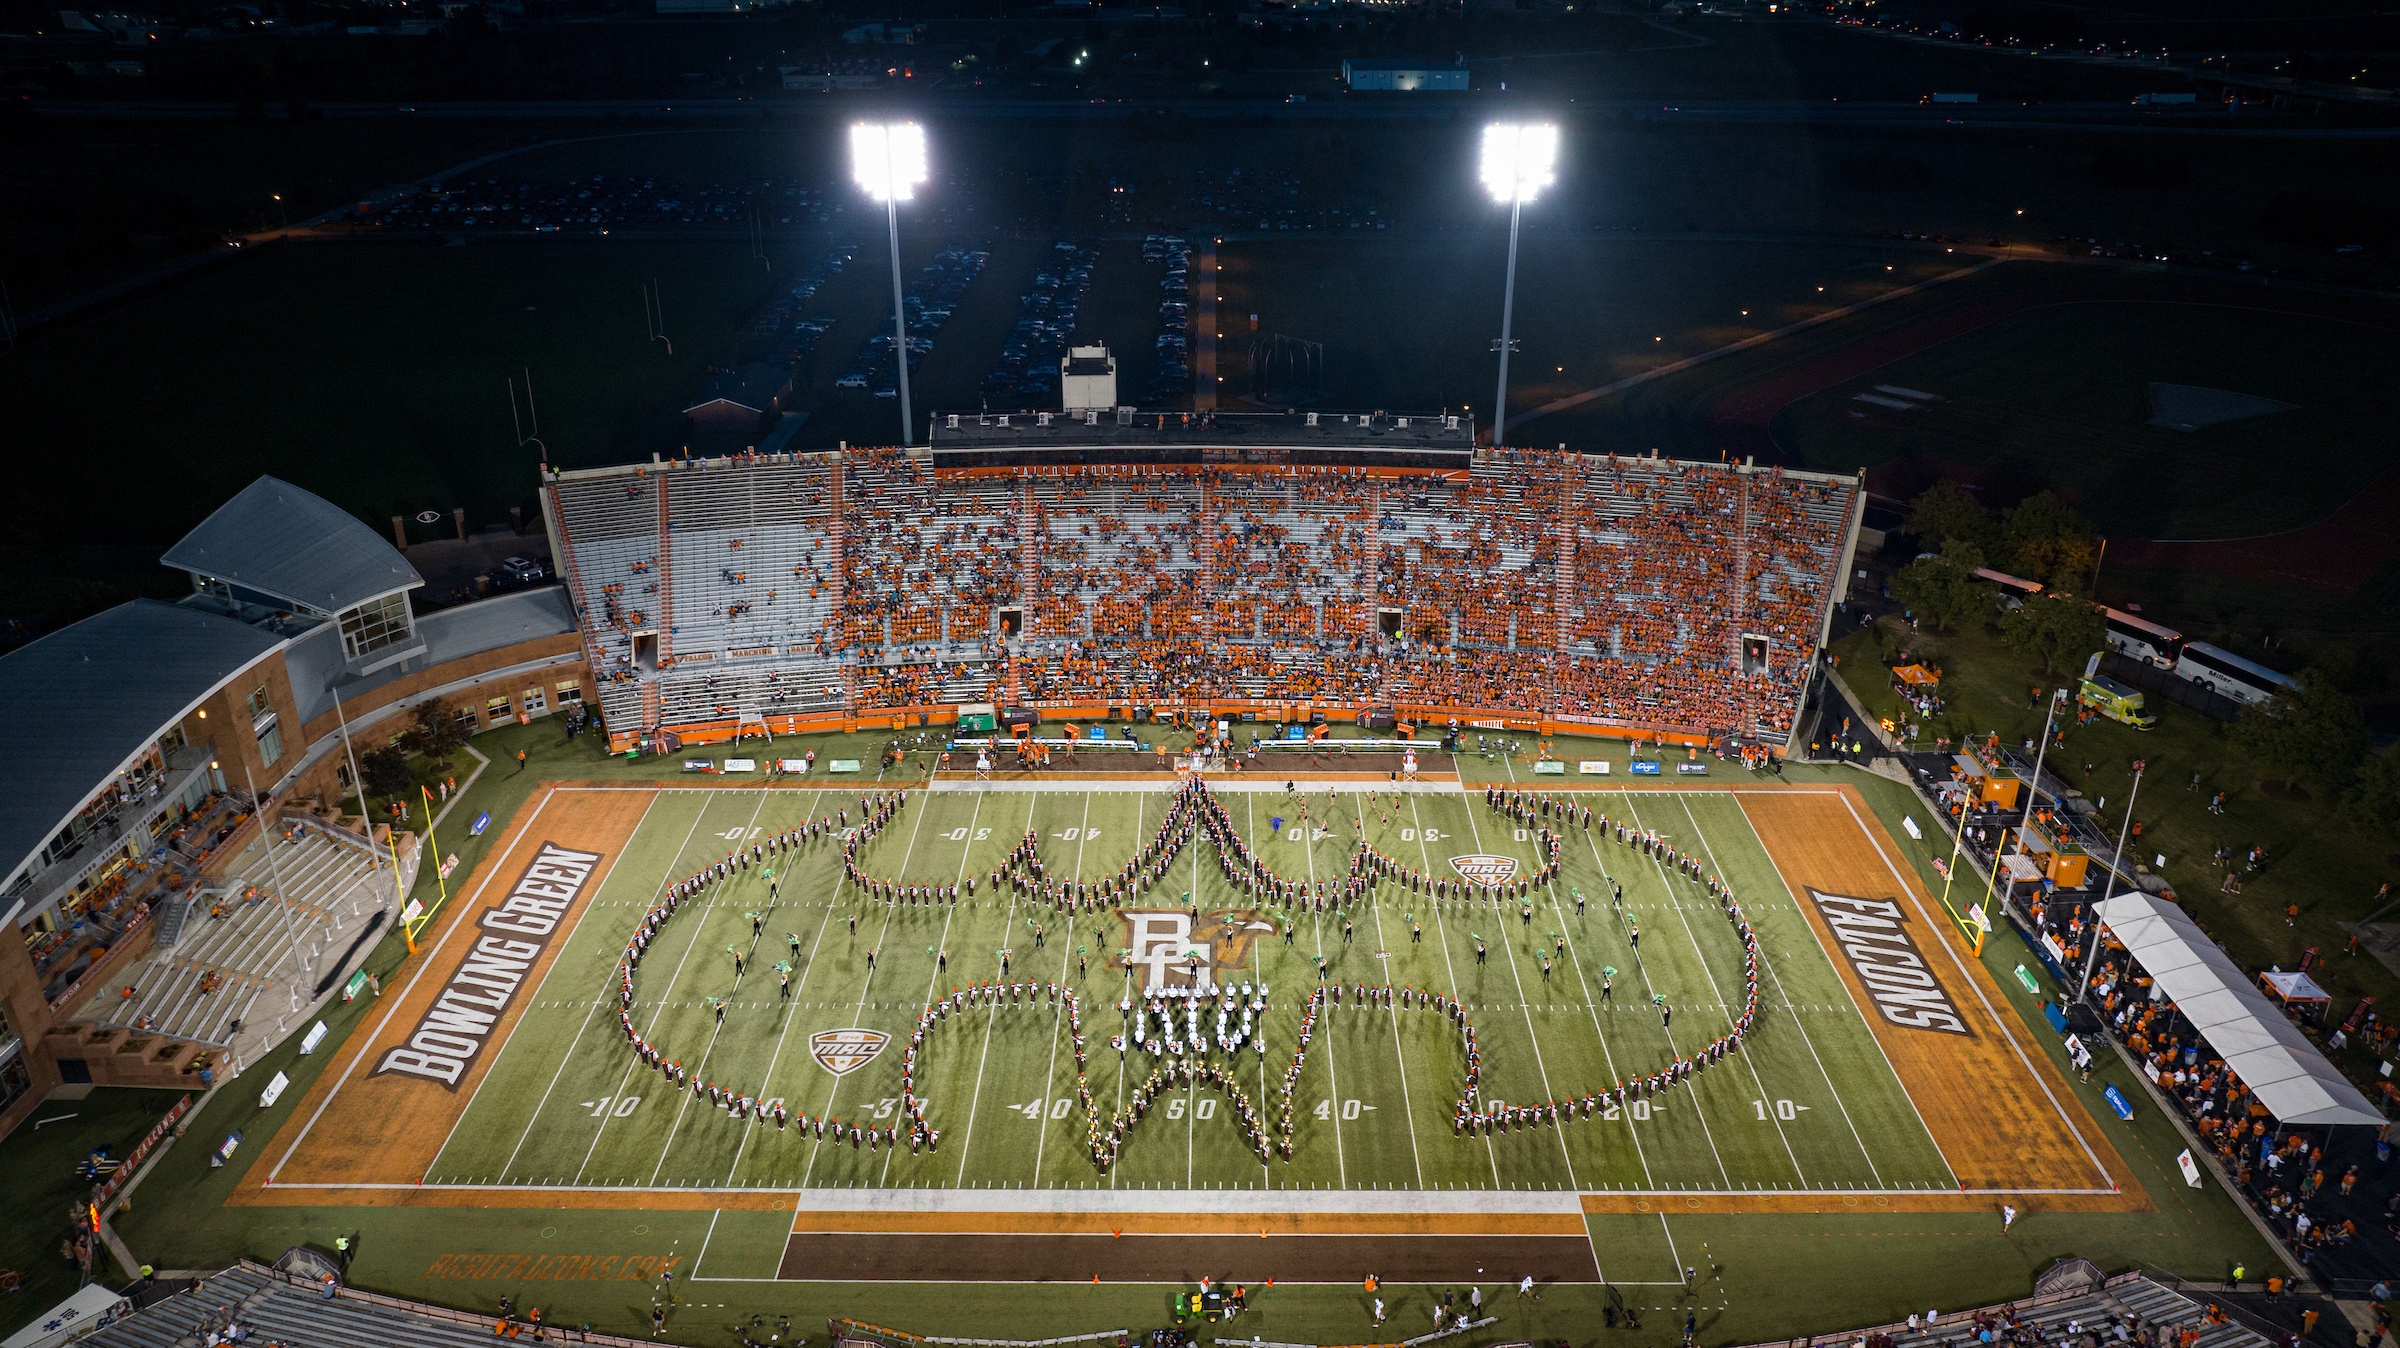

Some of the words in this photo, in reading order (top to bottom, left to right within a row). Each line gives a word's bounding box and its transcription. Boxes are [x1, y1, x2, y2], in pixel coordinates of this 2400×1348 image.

[1250, 699, 1356, 709] FOOTBALL
[1882, 718, 1895, 732] 25
[1459, 865, 1514, 874] MAC
[377, 935, 542, 1086] BOWLING
[482, 844, 600, 936] GREEN
[1120, 913, 1211, 997] BG
[1811, 890, 1967, 1033] FALCONS
[813, 1043, 882, 1055] MAC
[597, 1095, 642, 1118] 10
[1022, 1098, 1073, 1120] 40
[1166, 1099, 1217, 1120] 50
[1313, 1099, 1362, 1121] 40
[1602, 1099, 1651, 1122] 20
[1755, 1099, 1797, 1122] 10
[121, 1158, 134, 1177] GO
[135, 1111, 175, 1160] FALCONS
[420, 1253, 683, 1281] BGSUFALCONS.COM
